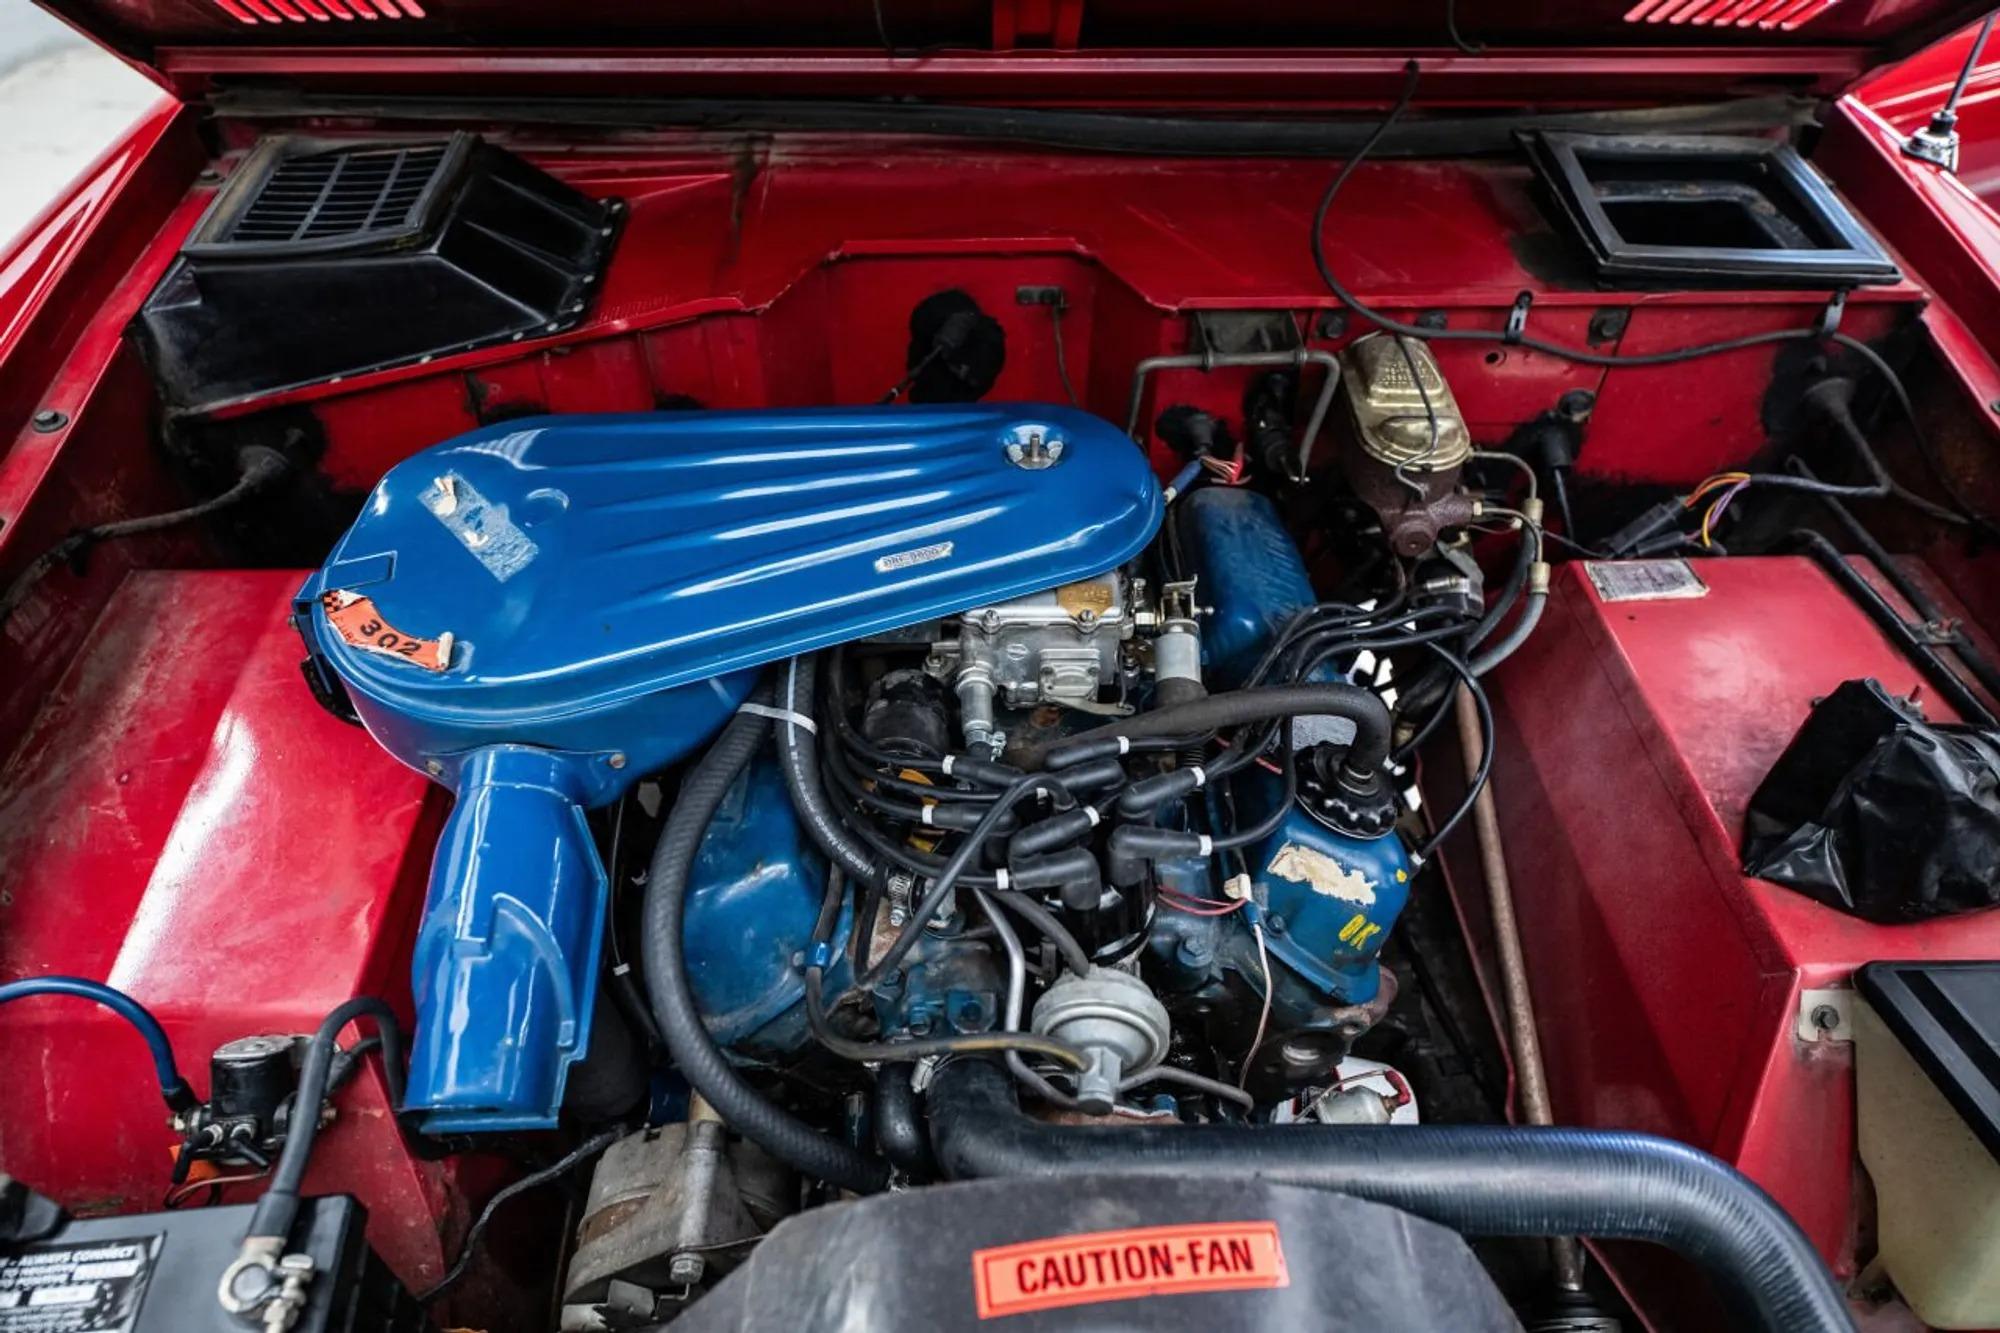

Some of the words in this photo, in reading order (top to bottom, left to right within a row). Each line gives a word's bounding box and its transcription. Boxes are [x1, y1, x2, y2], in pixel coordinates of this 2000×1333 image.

[360, 619, 422, 656] 302
[1339, 914, 1381, 950] OK
[1016, 1239, 1254, 1295] CAUTION-FAN
